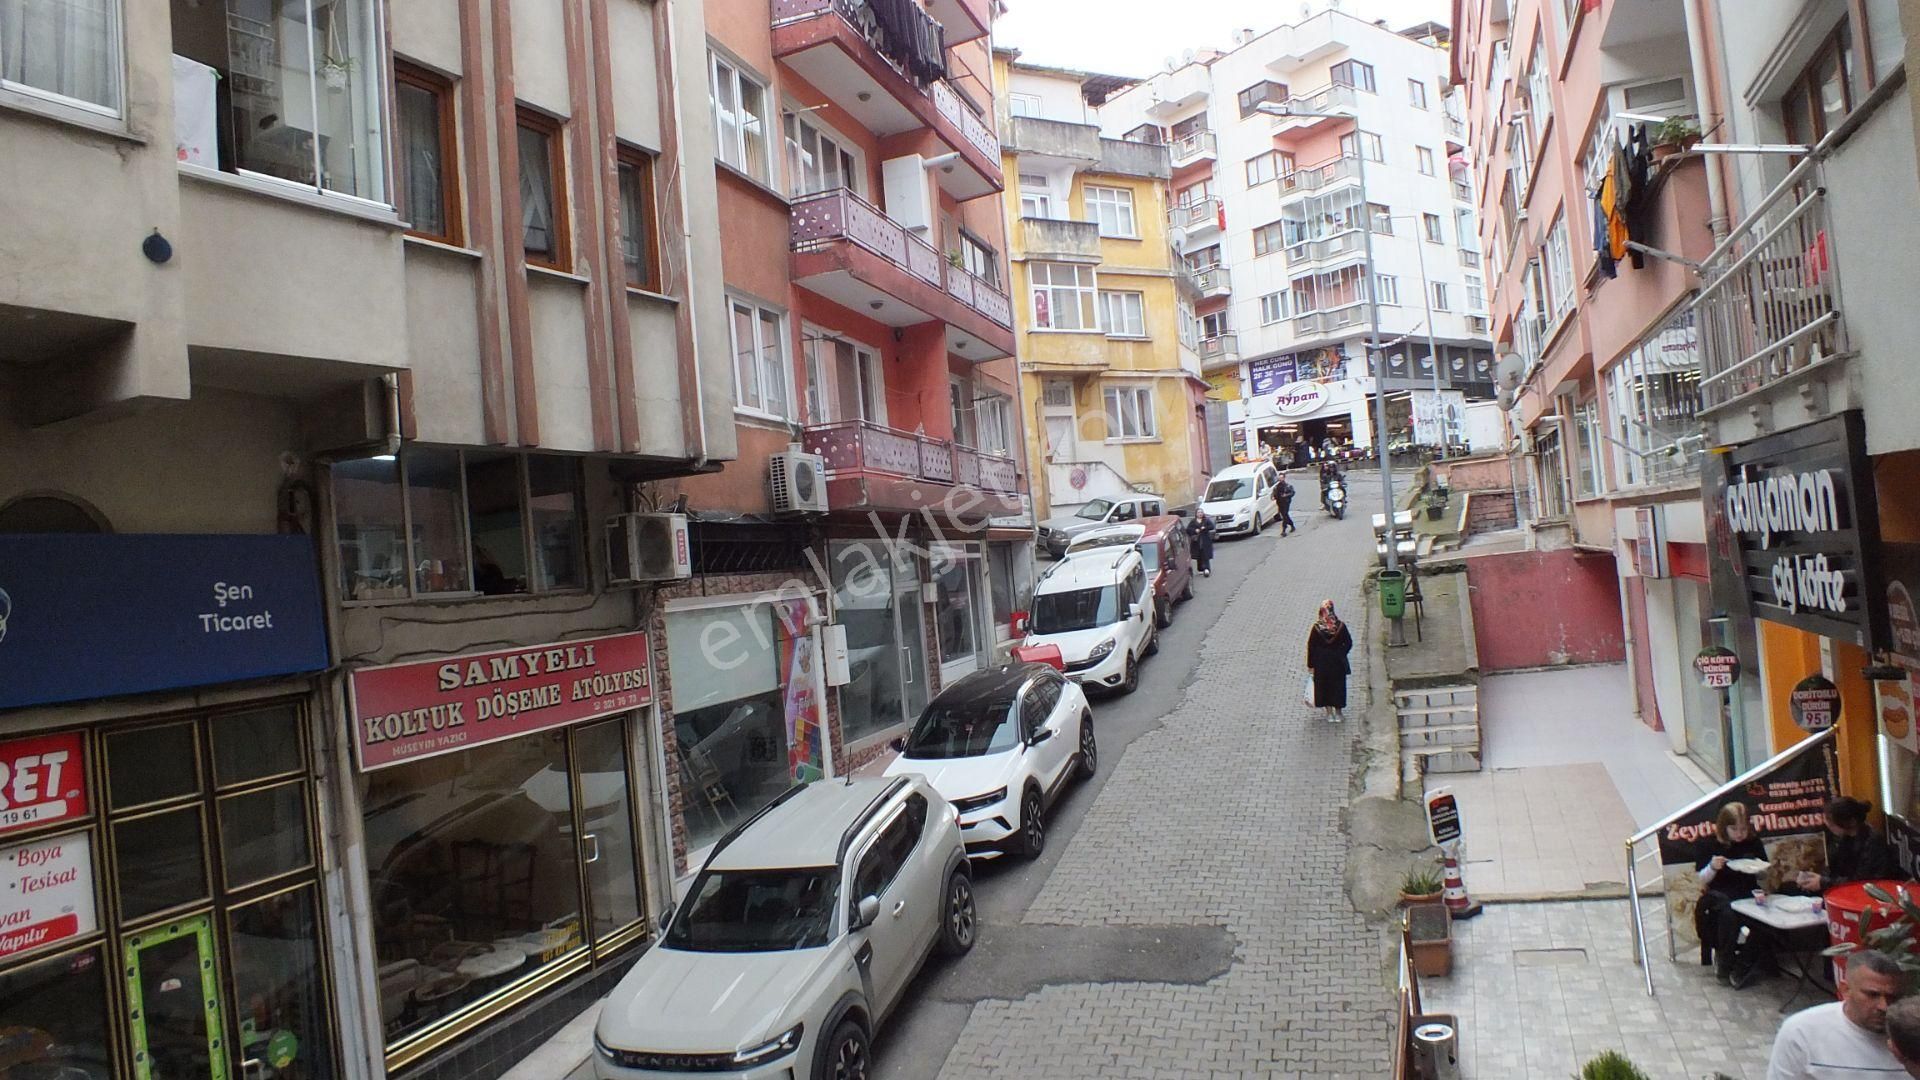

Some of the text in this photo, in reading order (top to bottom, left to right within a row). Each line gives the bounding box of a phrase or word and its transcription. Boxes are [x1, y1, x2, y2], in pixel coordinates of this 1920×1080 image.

[1275, 392, 1319, 406] Aypam
[1726, 464, 1838, 550] adıyaman
[213, 581, 253, 607] Şen
[1772, 552, 1846, 615] çiğ köfte
[198, 610, 273, 633] Ticaret
[364, 664, 649, 745] KOLTUK DÖŞEME ATÖLYESİ
[17, 846, 62, 867] Boya
[20, 867, 77, 894] Tesisat
[623, 1055, 718, 1067] RENAULT
